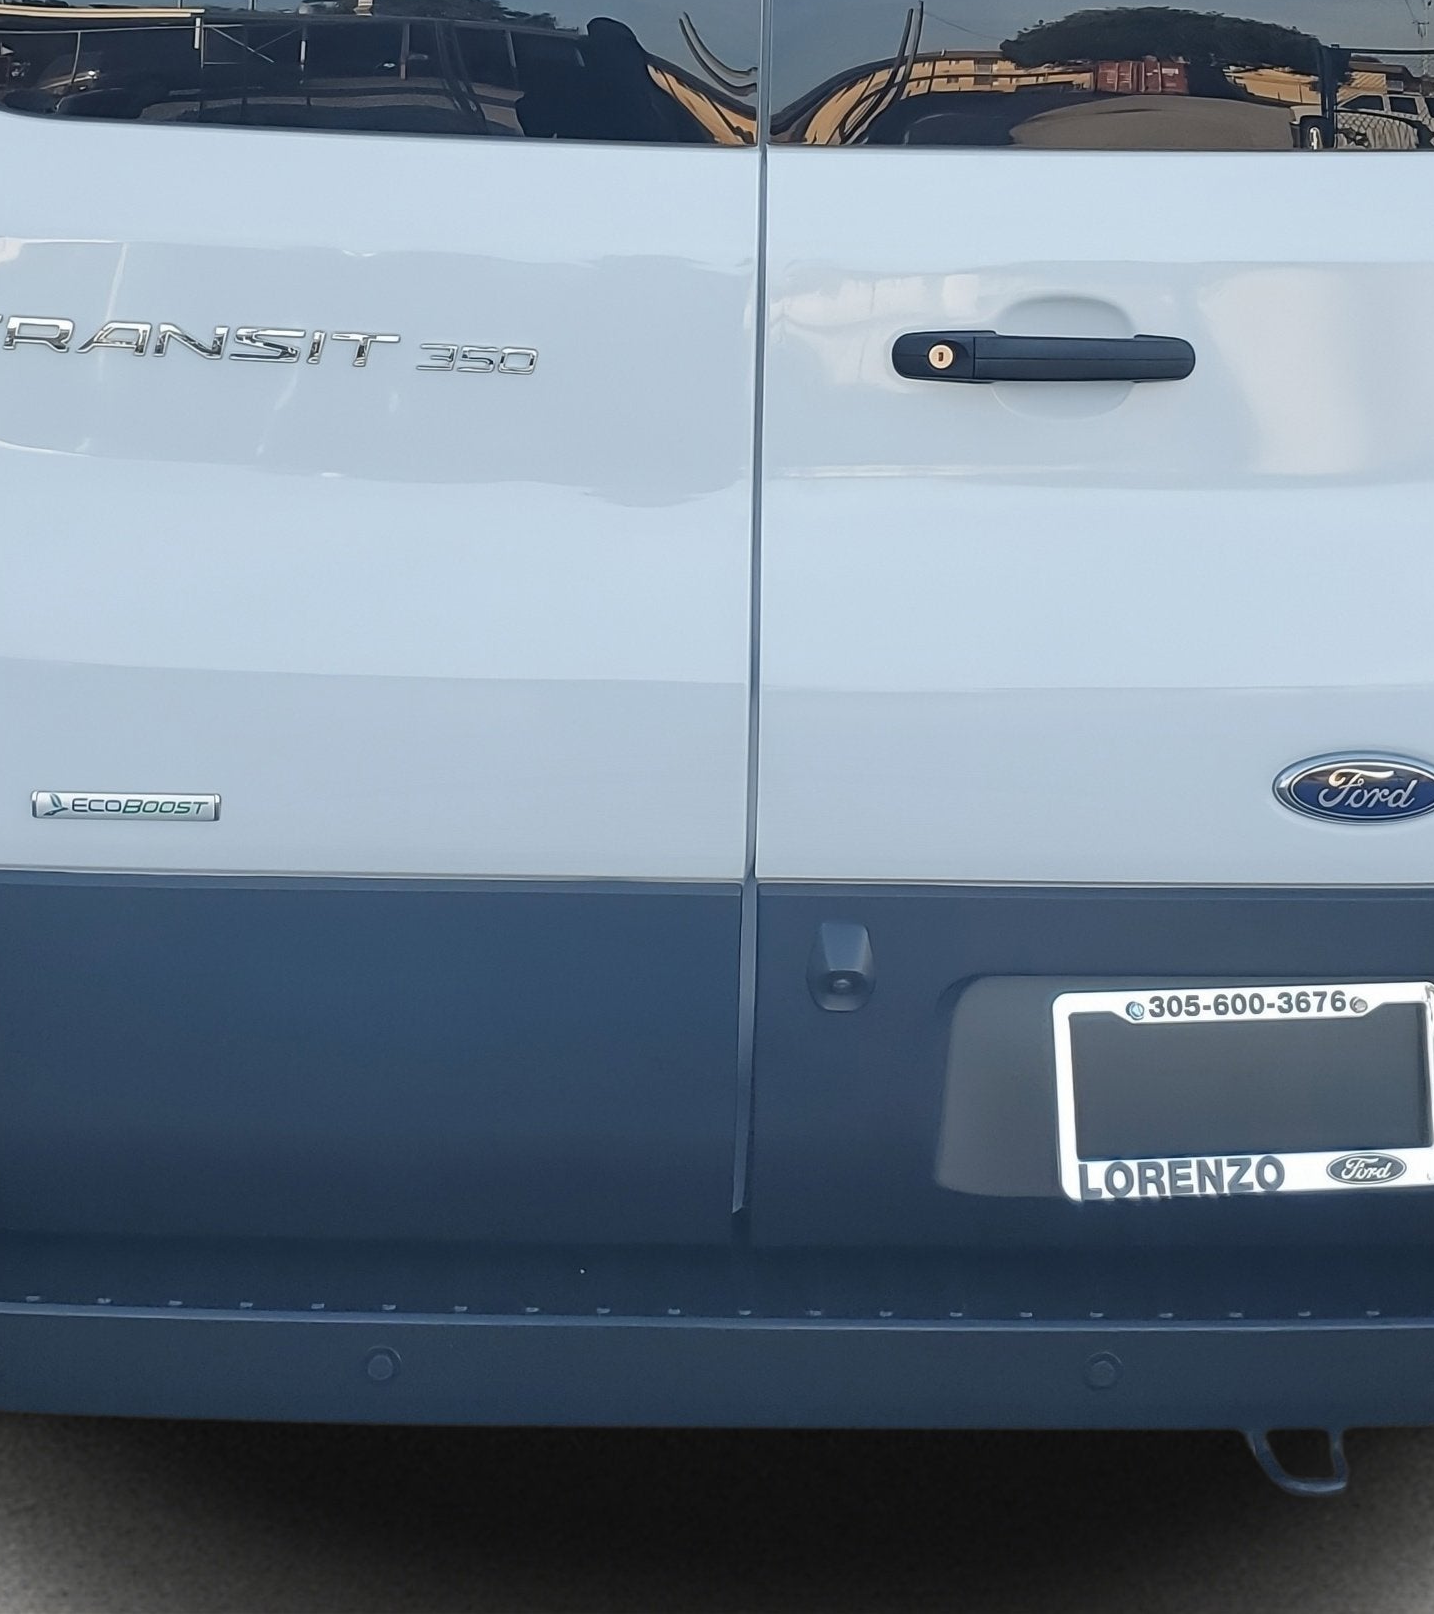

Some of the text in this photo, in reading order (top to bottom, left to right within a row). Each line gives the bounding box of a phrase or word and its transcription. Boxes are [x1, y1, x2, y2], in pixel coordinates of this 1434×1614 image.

[415, 343, 540, 376] 350
[1317, 768, 1418, 809] Ford
[1148, 990, 1347, 1019] 305-600-3676
[1077, 1154, 1392, 1202] LORENZO Ford
